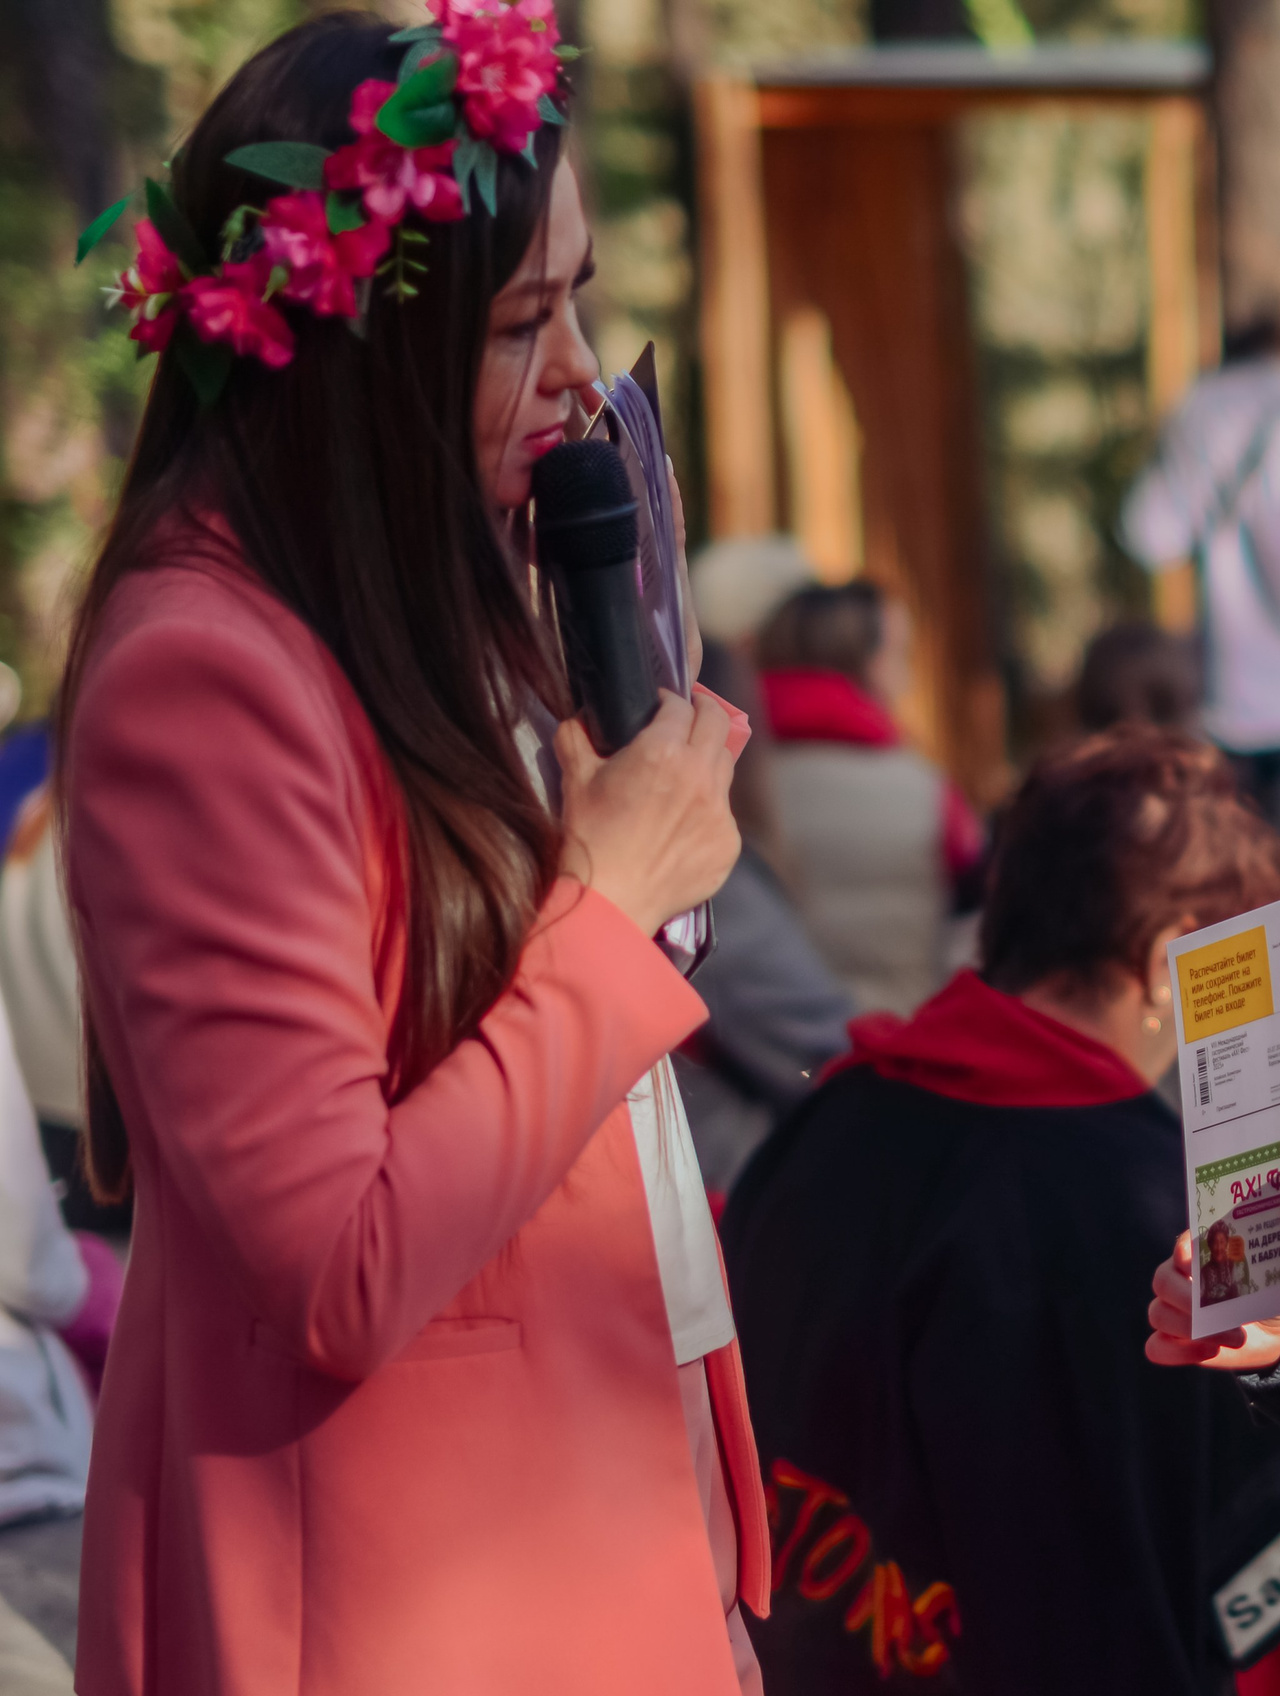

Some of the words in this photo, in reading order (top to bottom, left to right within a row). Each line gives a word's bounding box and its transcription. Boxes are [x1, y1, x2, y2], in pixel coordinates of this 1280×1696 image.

[1189, 957, 1235, 980] Распечатайте
[1236, 949, 1257, 964] билет
[1191, 983, 1204, 995] или
[1205, 970, 1240, 988] сохраните
[1241, 966, 1251, 977] на
[1228, 976, 1263, 996] Покажите
[1194, 1008, 1214, 1023] билет
[1215, 1006, 1224, 1015] на
[1225, 997, 1246, 1012] входе
[1230, 1173, 1262, 1205] АХ!
[1248, 1237, 1260, 1249] НА
[1251, 1254, 1257, 1265] К
